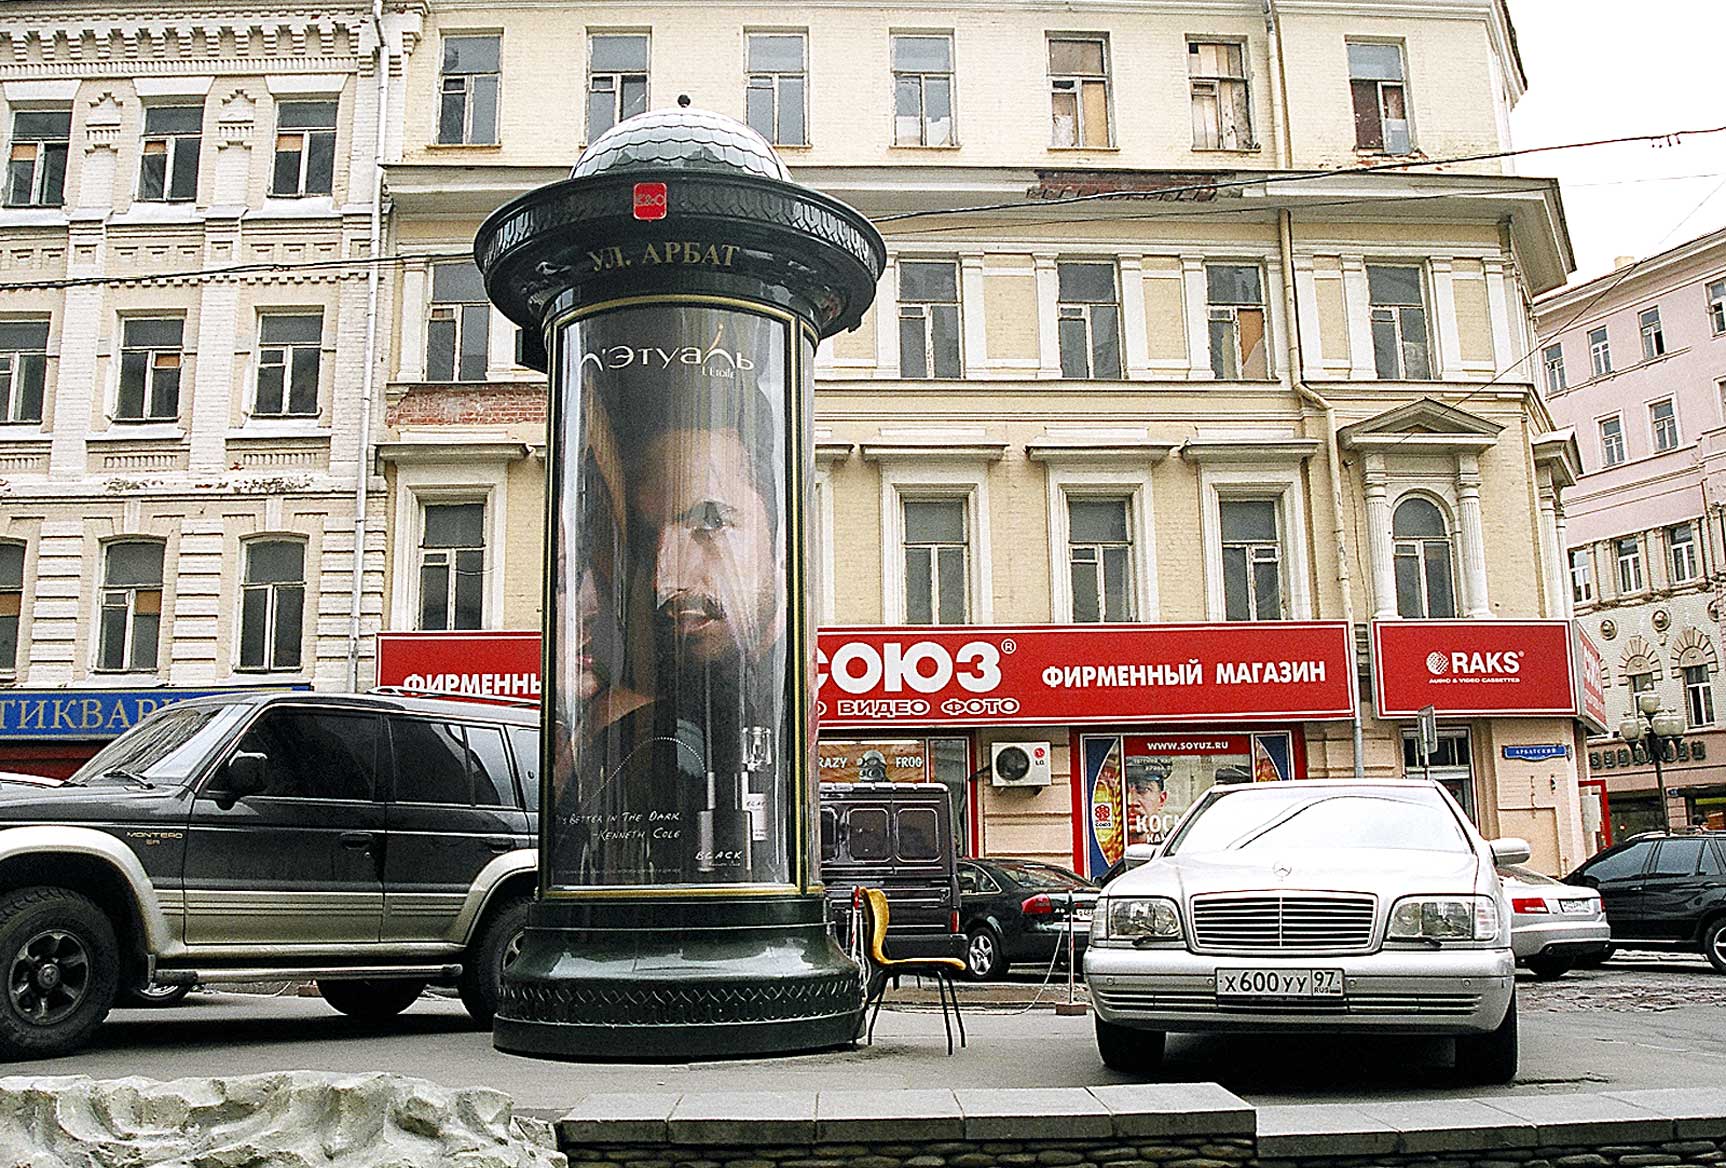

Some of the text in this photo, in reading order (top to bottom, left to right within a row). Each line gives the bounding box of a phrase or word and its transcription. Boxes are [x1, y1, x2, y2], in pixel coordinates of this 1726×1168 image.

[587, 241, 741, 272] УЛ. АРБАТ
[1451, 651, 1521, 674] RAKS
[1041, 658, 1327, 688] ФИРМЕННЫЙ МАГАЗИН
[0, 698, 187, 730] ТИКВАР
[837, 699, 931, 718] ВИДЕО
[940, 698, 1021, 715] ФОТО
[1147, 740, 1229, 751] WWW.SOYUZ.RU
[895, 756, 923, 768] FROG
[622, 811, 643, 823] THE
[648, 810, 680, 822] DARK
[127, 831, 183, 839] MONTERO
[695, 850, 743, 861] BLACK
[1314, 971, 1335, 987] 97
[1314, 986, 1329, 994] RUS
